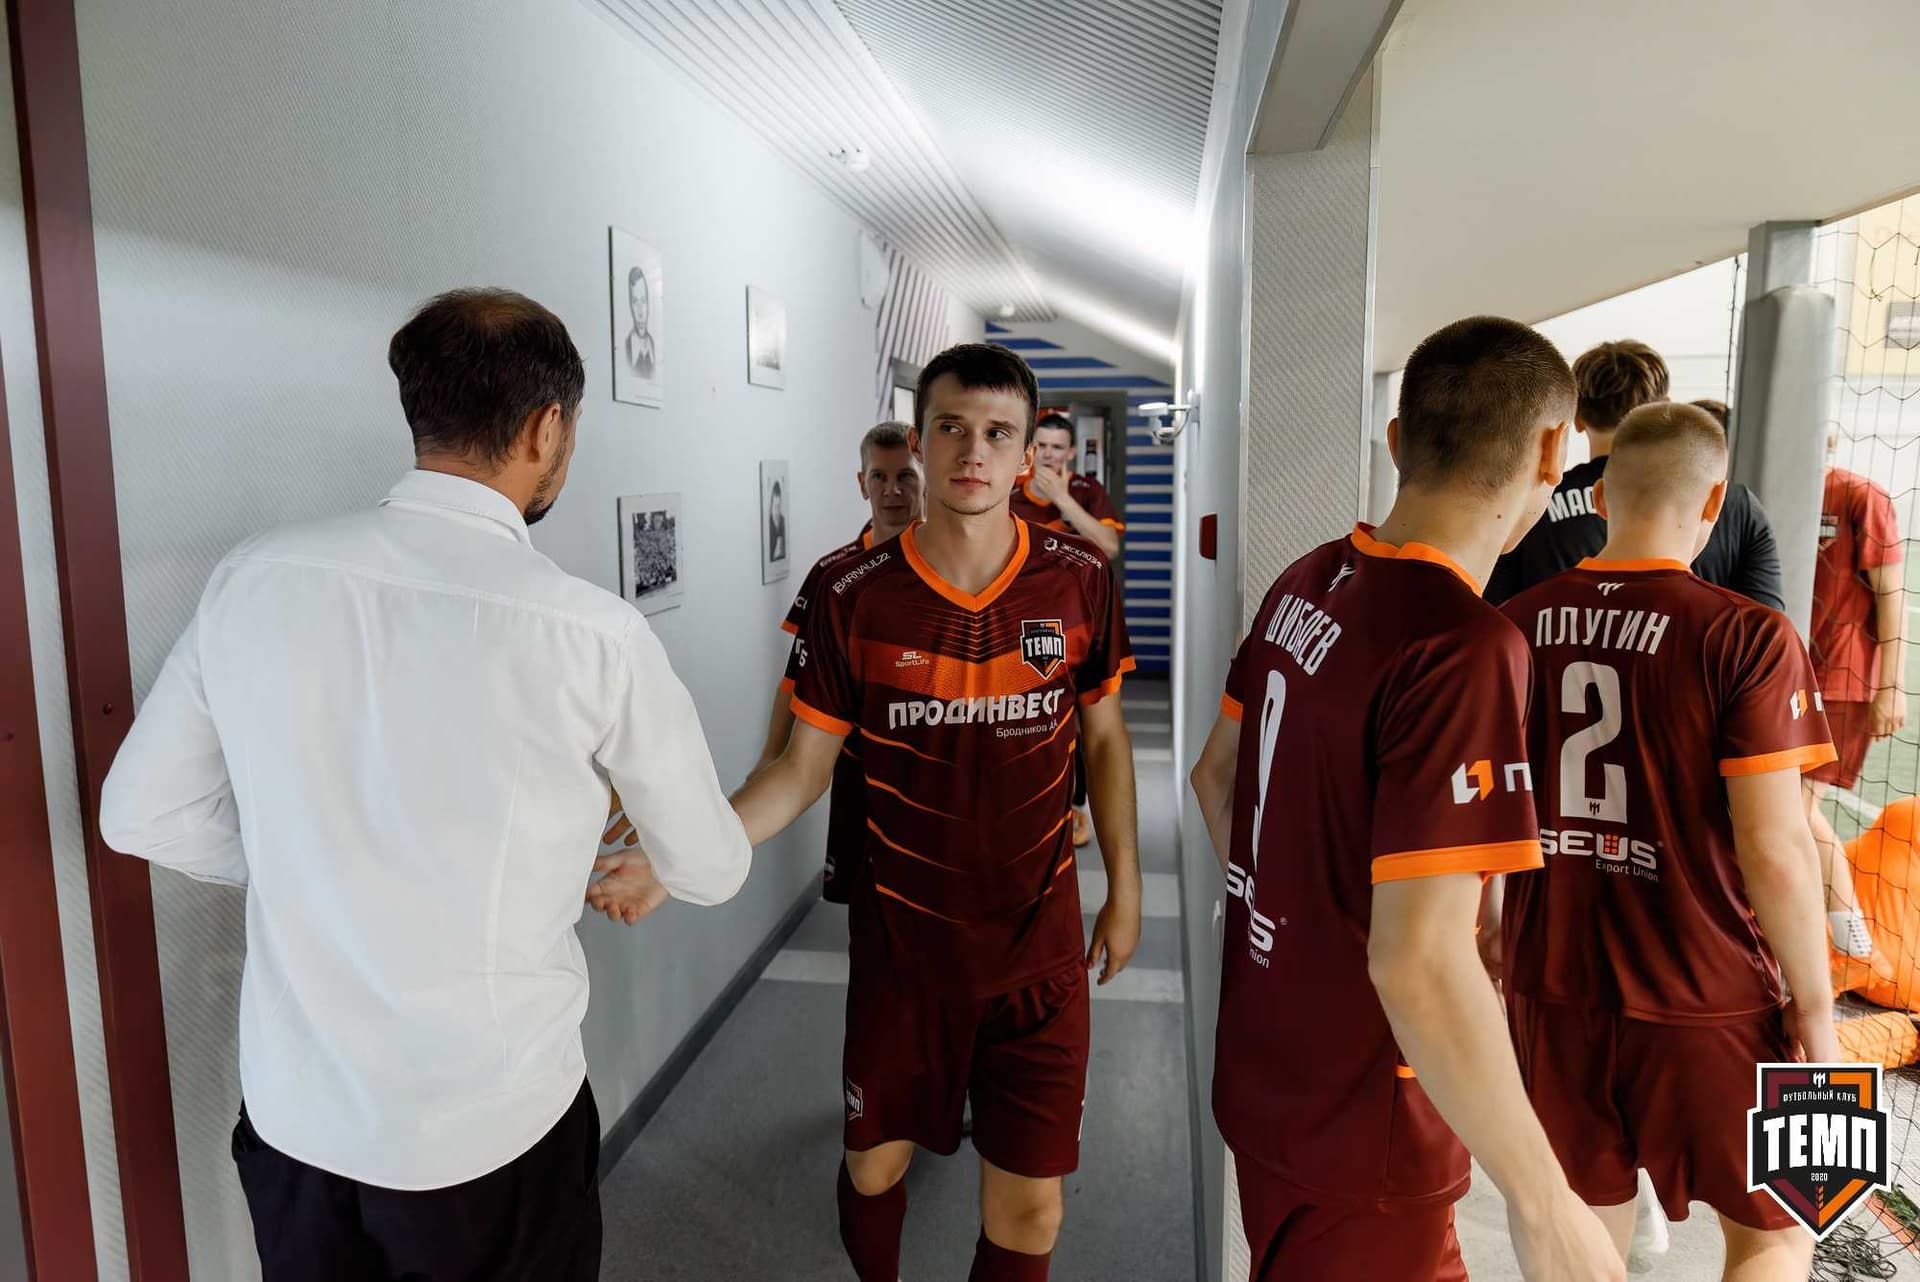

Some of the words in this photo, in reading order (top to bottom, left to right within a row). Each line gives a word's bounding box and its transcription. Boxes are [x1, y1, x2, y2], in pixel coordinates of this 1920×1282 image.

[1025, 637, 1062, 658] ТЕМП
[1535, 606, 1670, 655] ПЛУГИН
[888, 688, 1065, 730] ПРОДИНВЕСТ
[1560, 661, 1627, 824] 2
[1540, 828, 1657, 870] SEUS
[1595, 859, 1630, 875] Export
[1633, 867, 1658, 881] Union
[1249, 948, 1270, 969] nion
